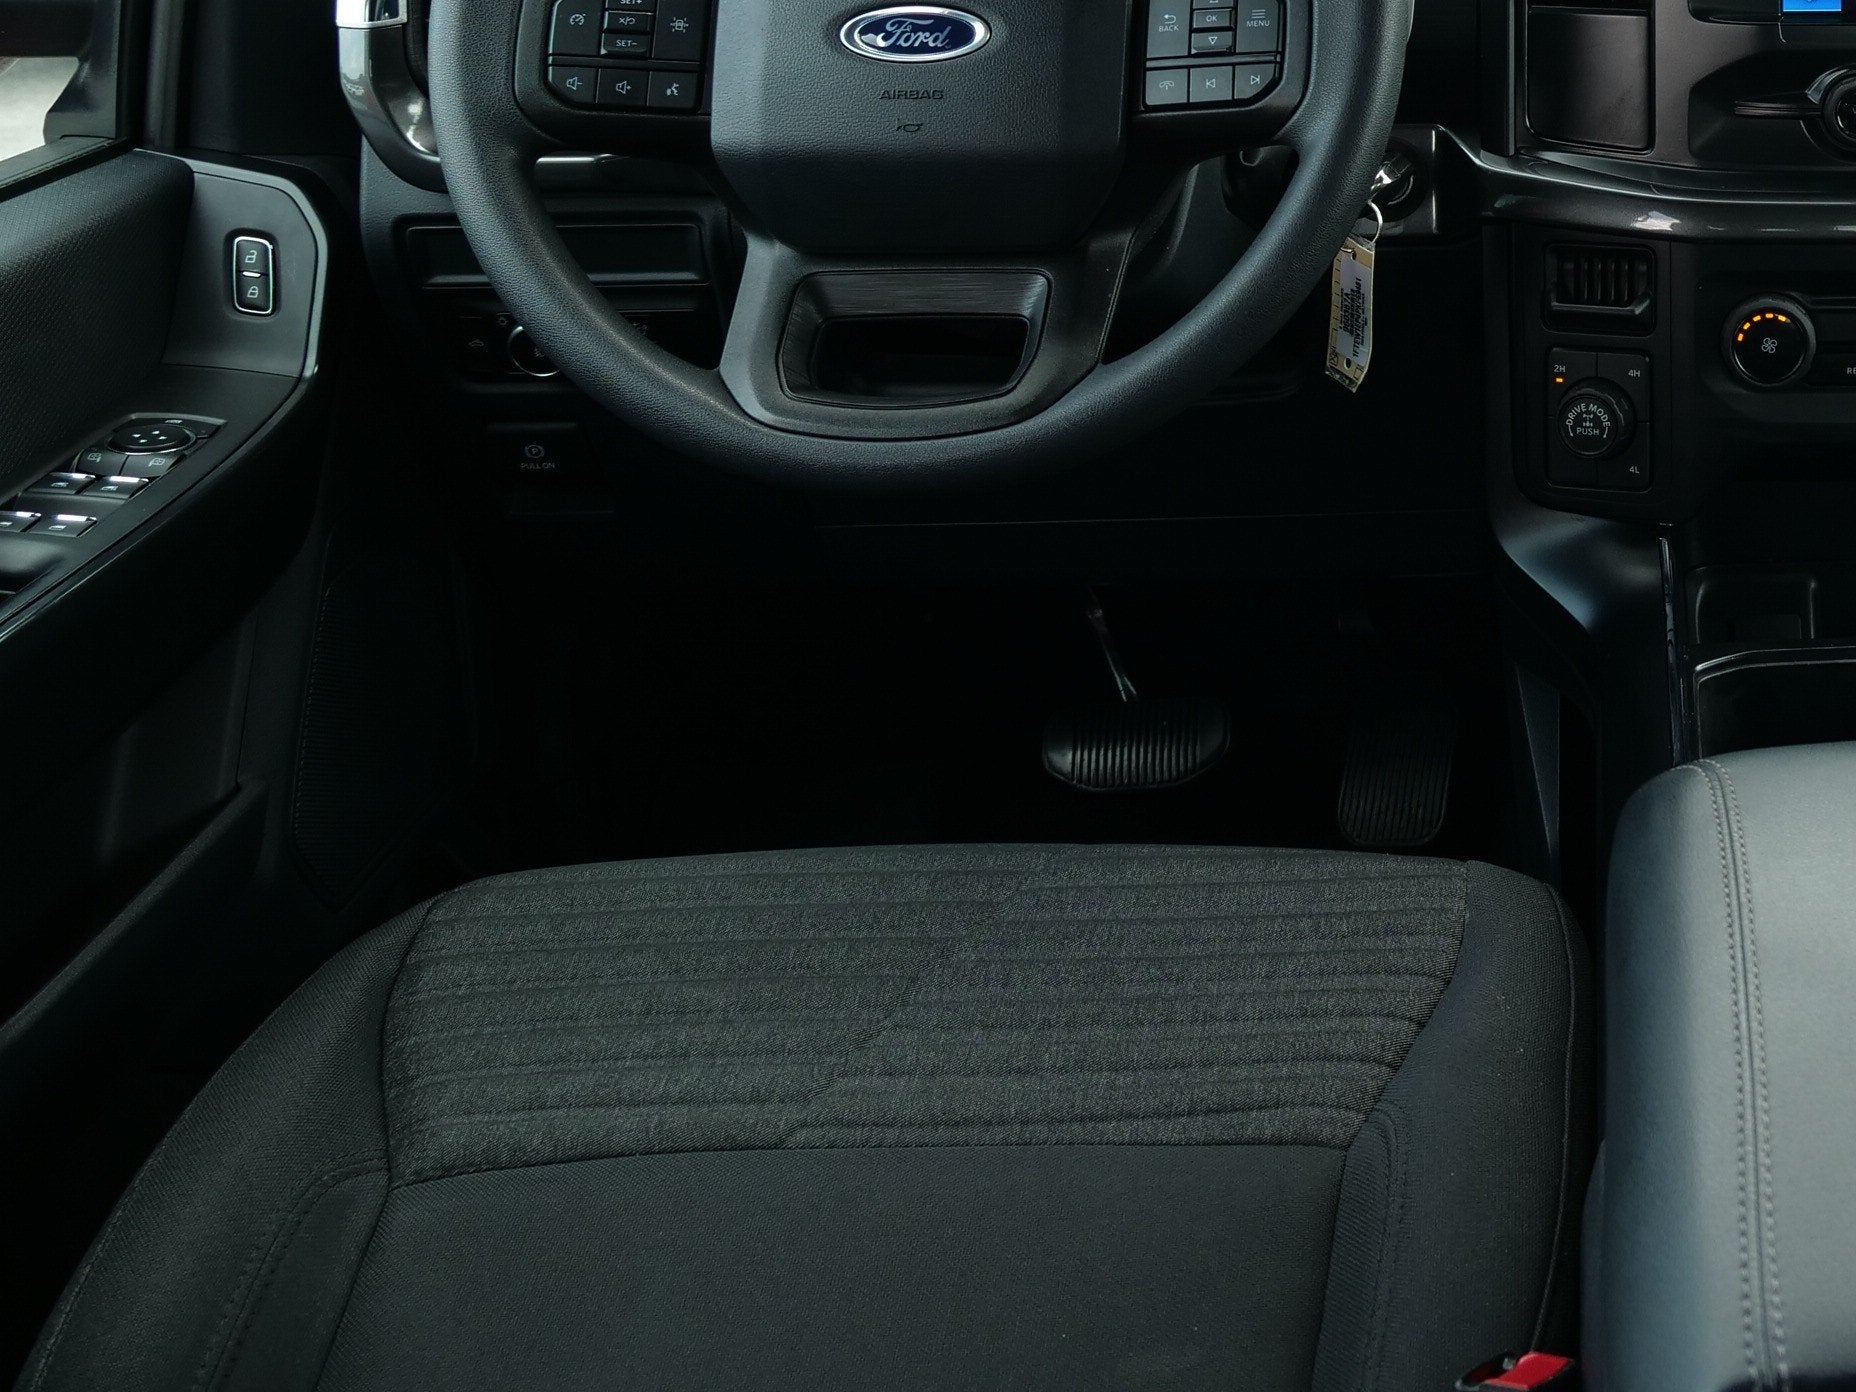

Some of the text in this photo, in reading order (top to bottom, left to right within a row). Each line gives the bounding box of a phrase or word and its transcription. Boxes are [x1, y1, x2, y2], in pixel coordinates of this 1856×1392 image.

[876, 17, 951, 48] Ford
[879, 89, 944, 100] AIRBAG
[1553, 364, 1566, 373] 2H
[1628, 369, 1641, 378] 4H
[1565, 403, 1611, 428] DRIVE MODE
[1576, 427, 1600, 436] PUSH
[1629, 466, 1640, 474] 4L
